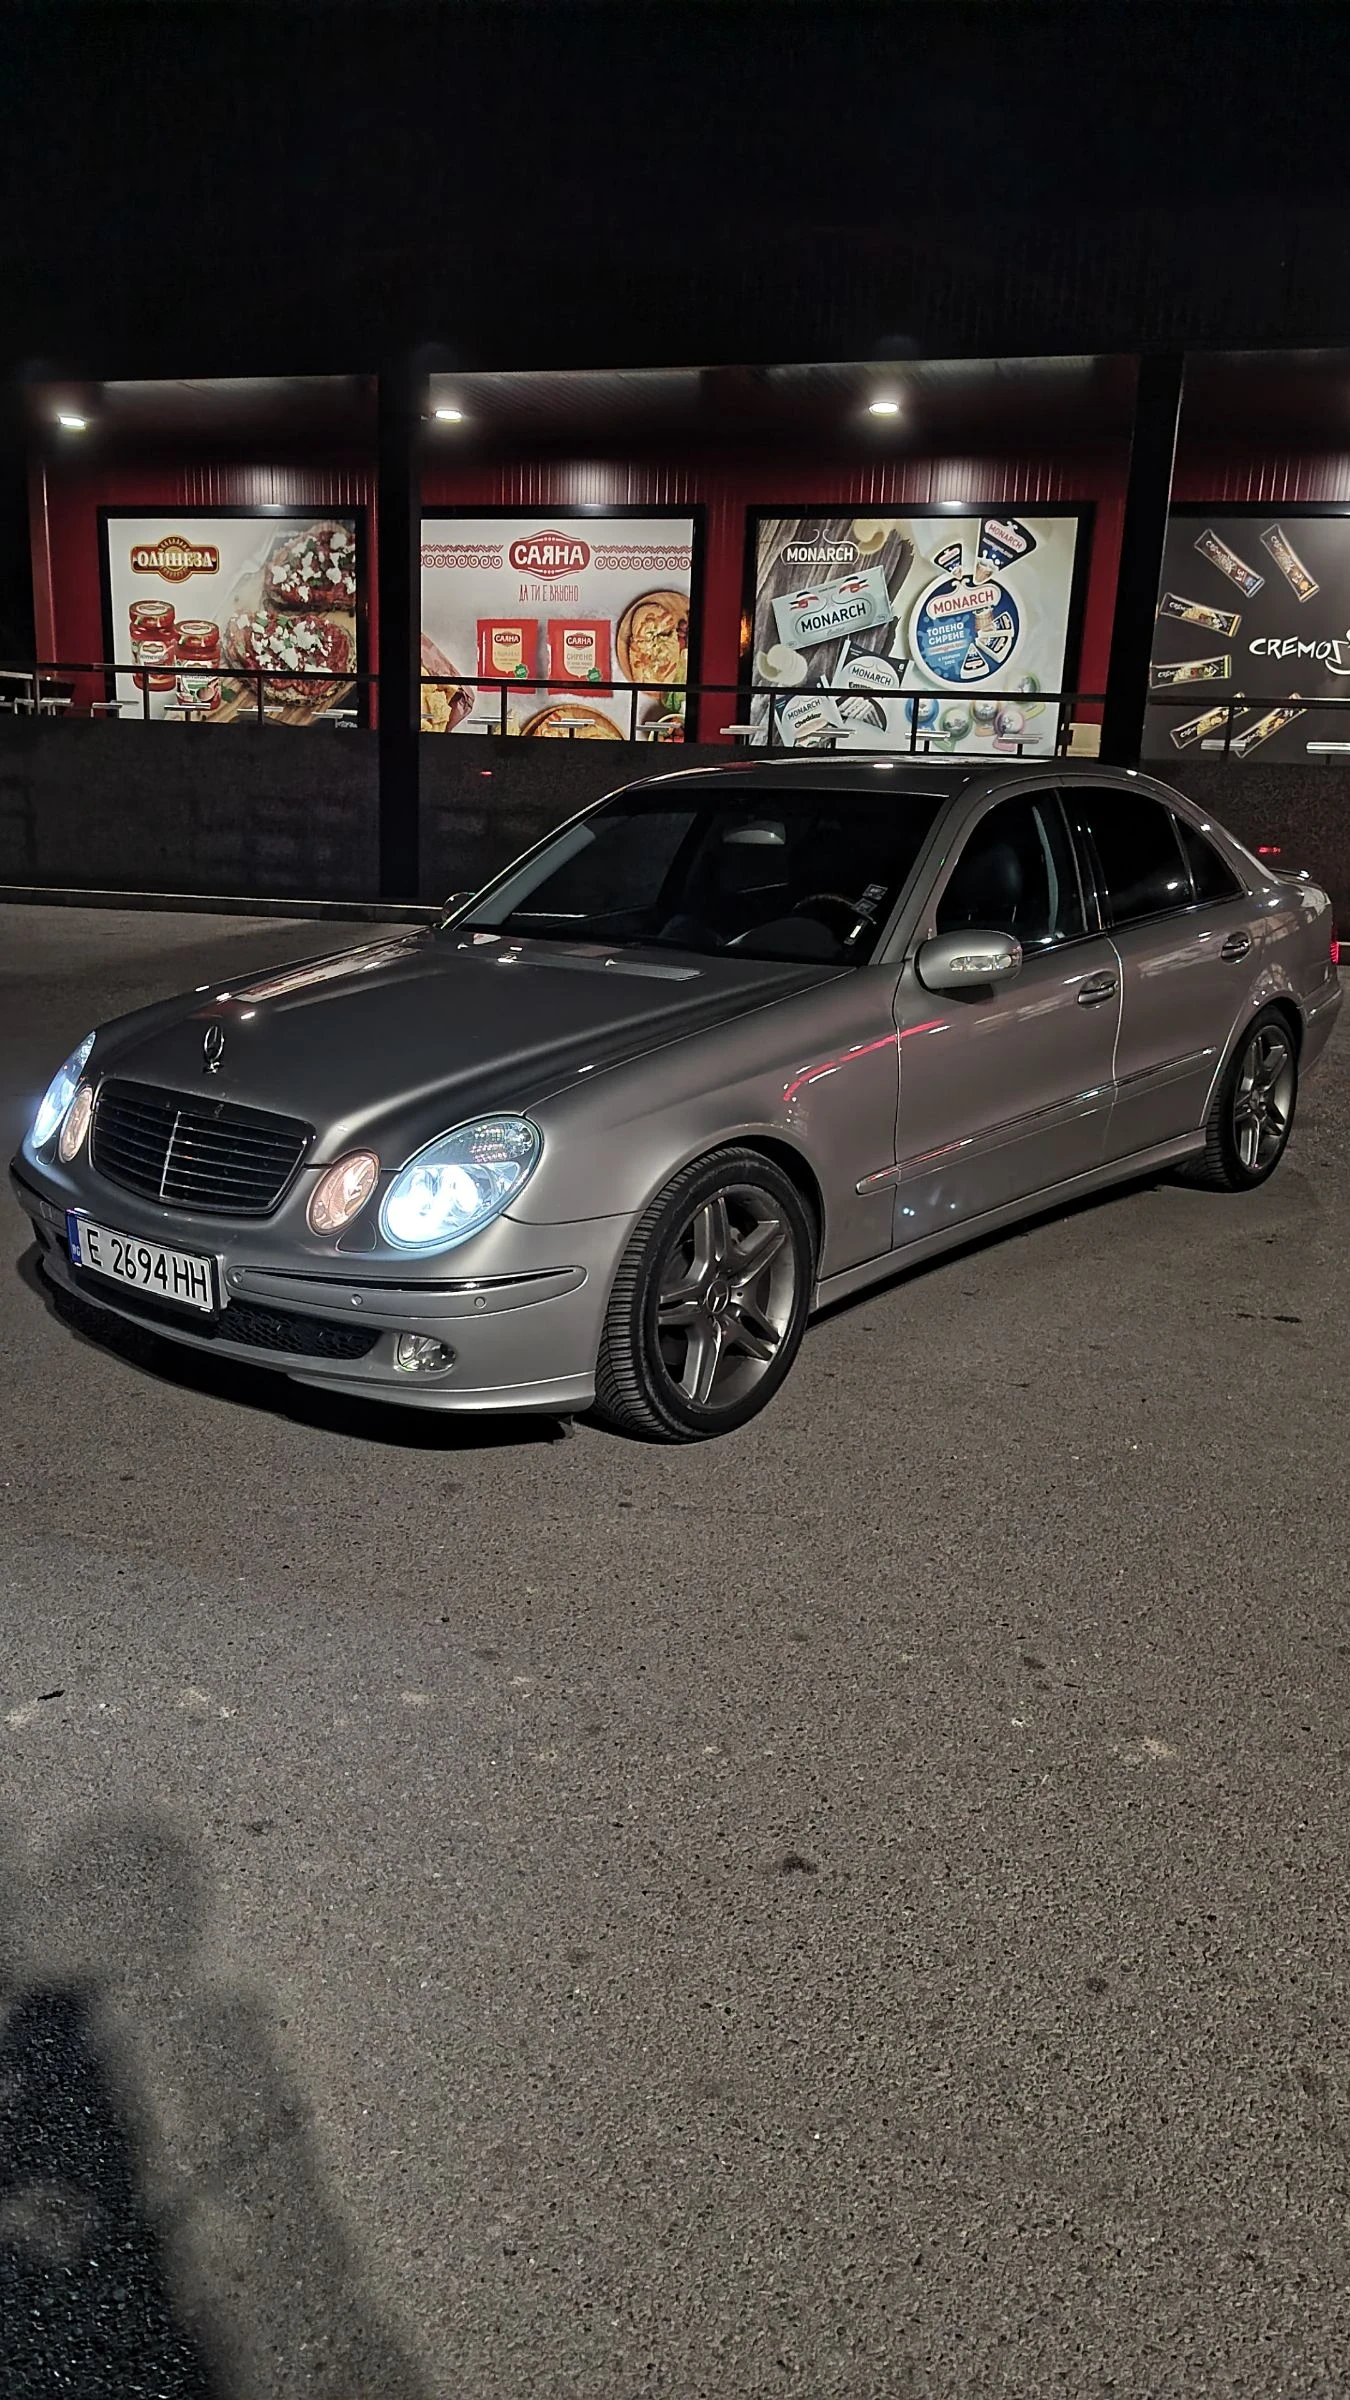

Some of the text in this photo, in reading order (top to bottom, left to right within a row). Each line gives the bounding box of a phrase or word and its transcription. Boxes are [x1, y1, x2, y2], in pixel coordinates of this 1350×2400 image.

[514, 544, 584, 565] САЯНА
[786, 547, 854, 562] MONARCH
[519, 584, 579, 602] ДА ТИ Е ВКУСНО
[933, 589, 994, 615] MONARCH
[801, 602, 867, 633] MONARCH
[926, 621, 964, 637] ТОПЕНО
[928, 630, 965, 645] СИРЕНЕ
[1248, 634, 1350, 668] CREMOS
[851, 666, 892, 686] MONARCH
[787, 699, 821, 720] MONARCH
[794, 712, 822, 729] Cheddar
[87, 1228, 103, 1267] E
